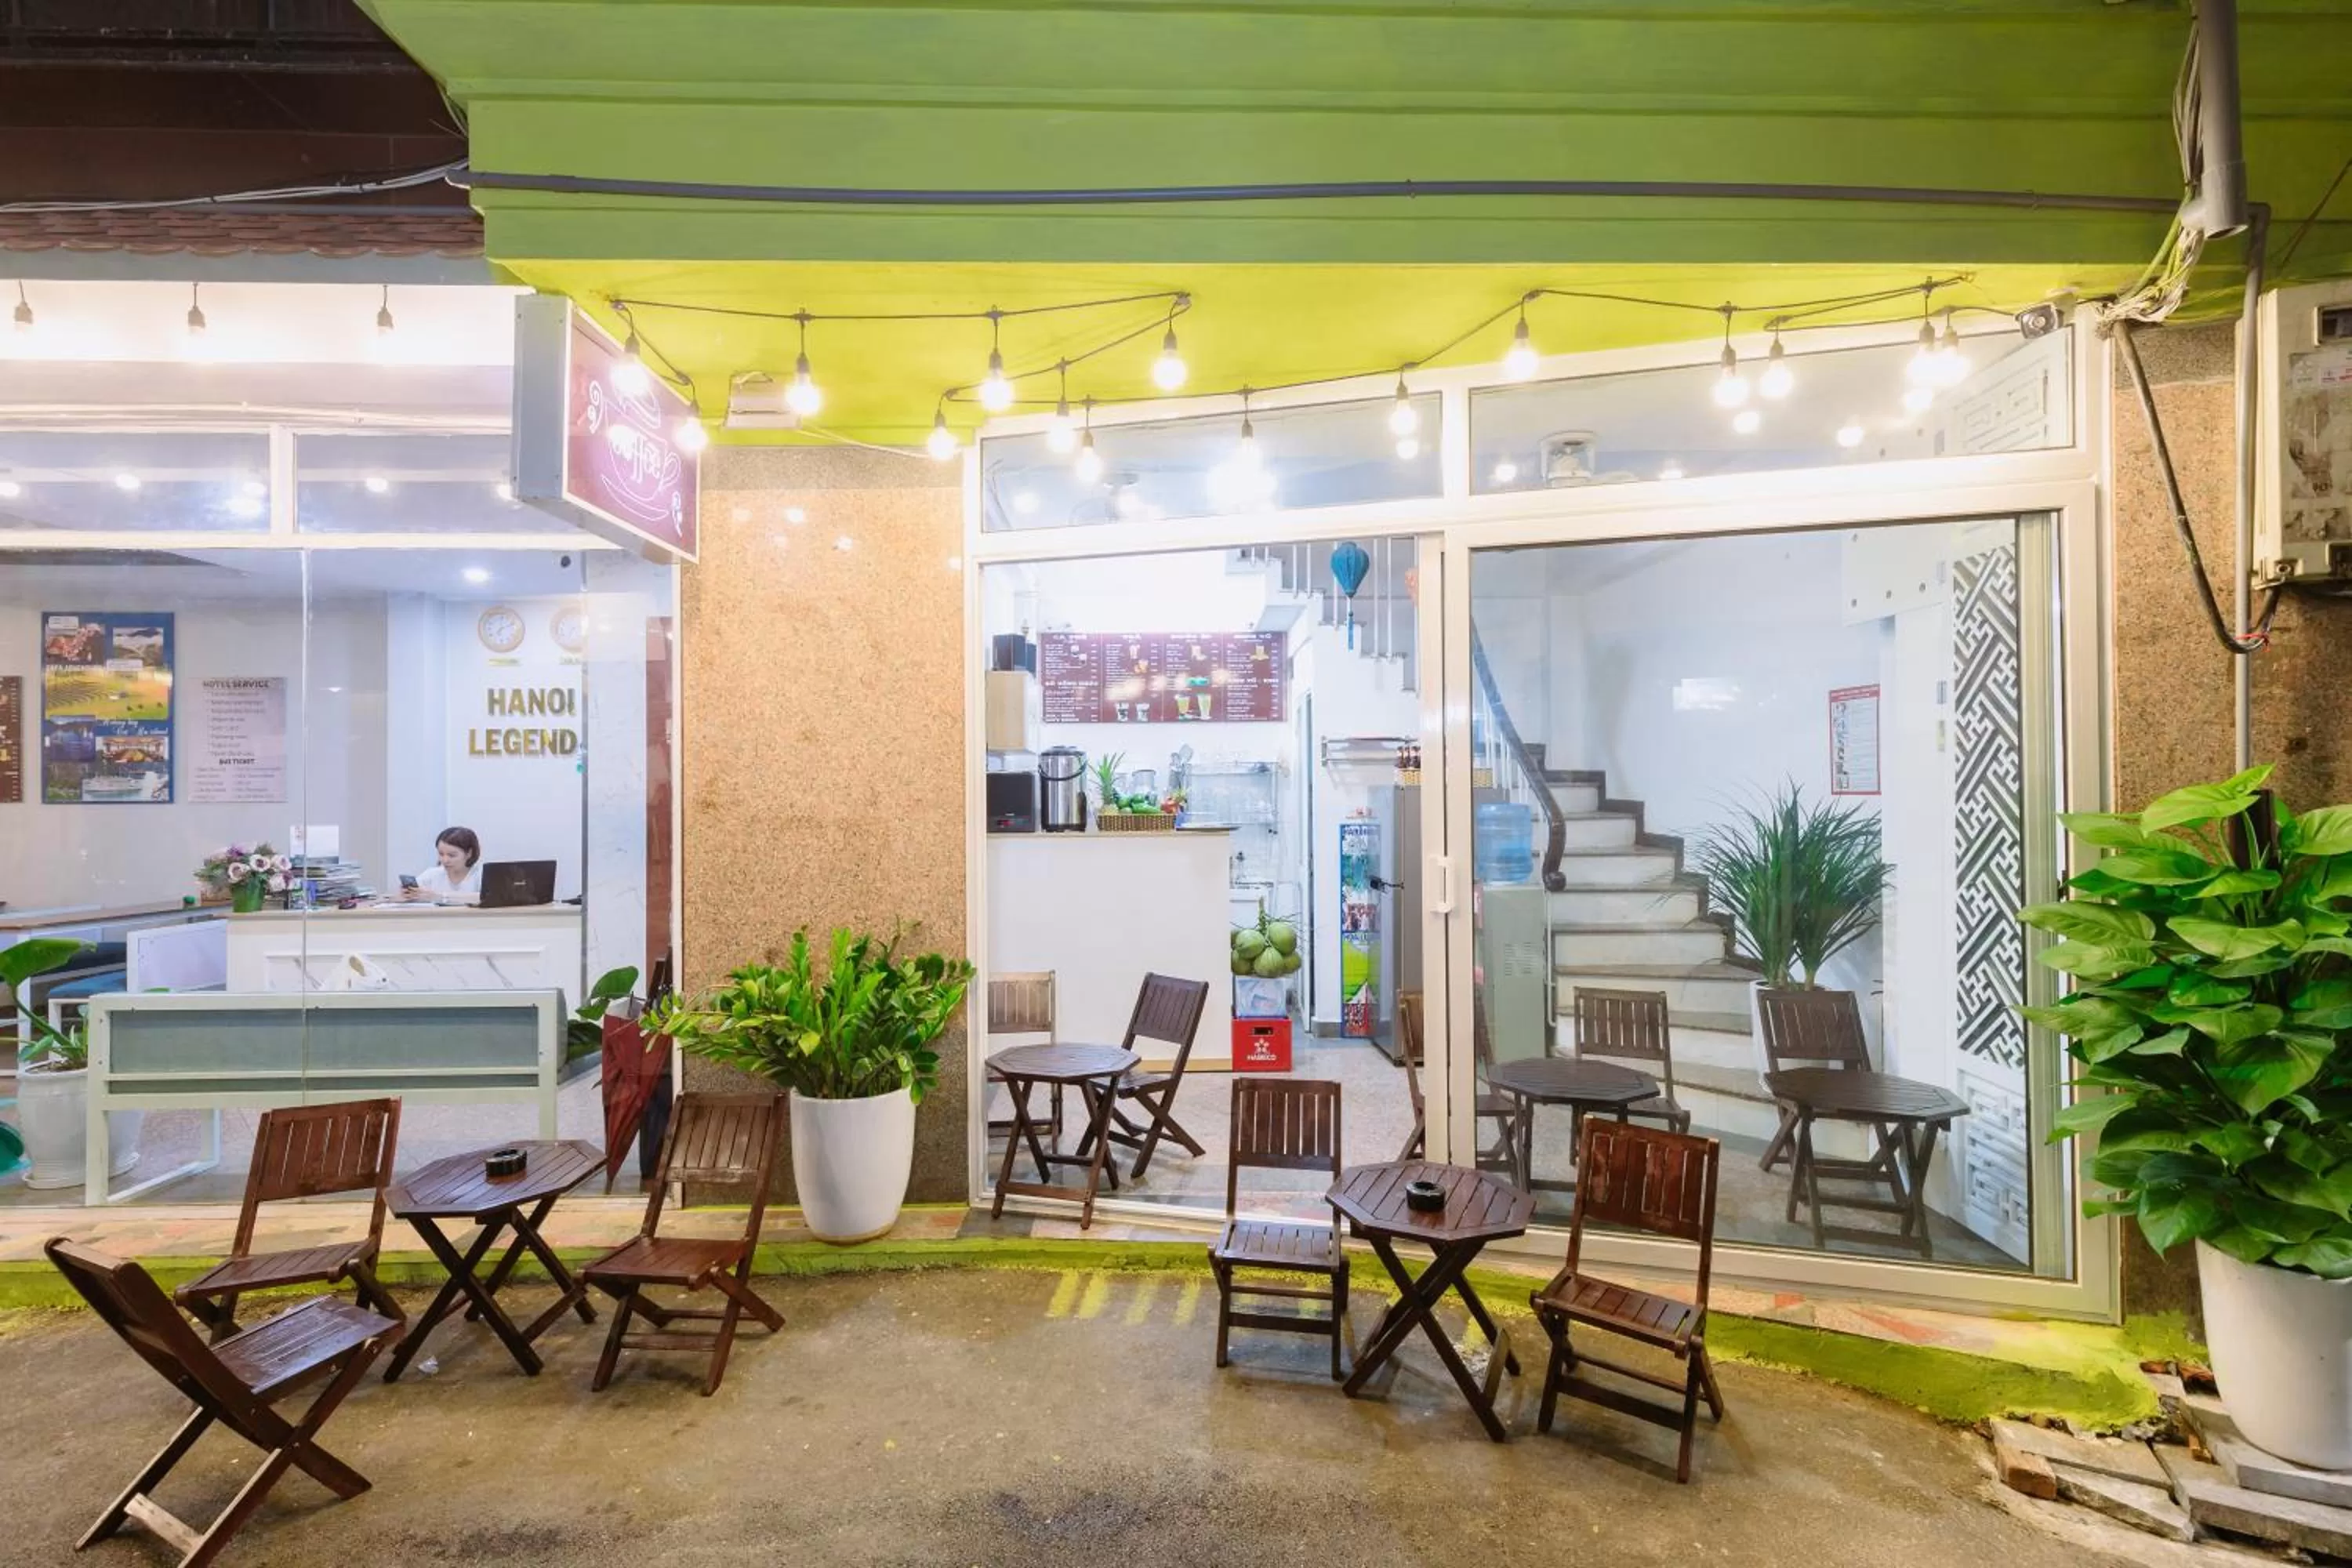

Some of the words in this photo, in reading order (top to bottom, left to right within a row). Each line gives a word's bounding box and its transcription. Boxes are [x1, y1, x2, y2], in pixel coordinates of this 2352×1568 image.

[609, 428, 660, 483] offee
[487, 688, 576, 716] HANOI
[468, 728, 578, 757] LEGEND
